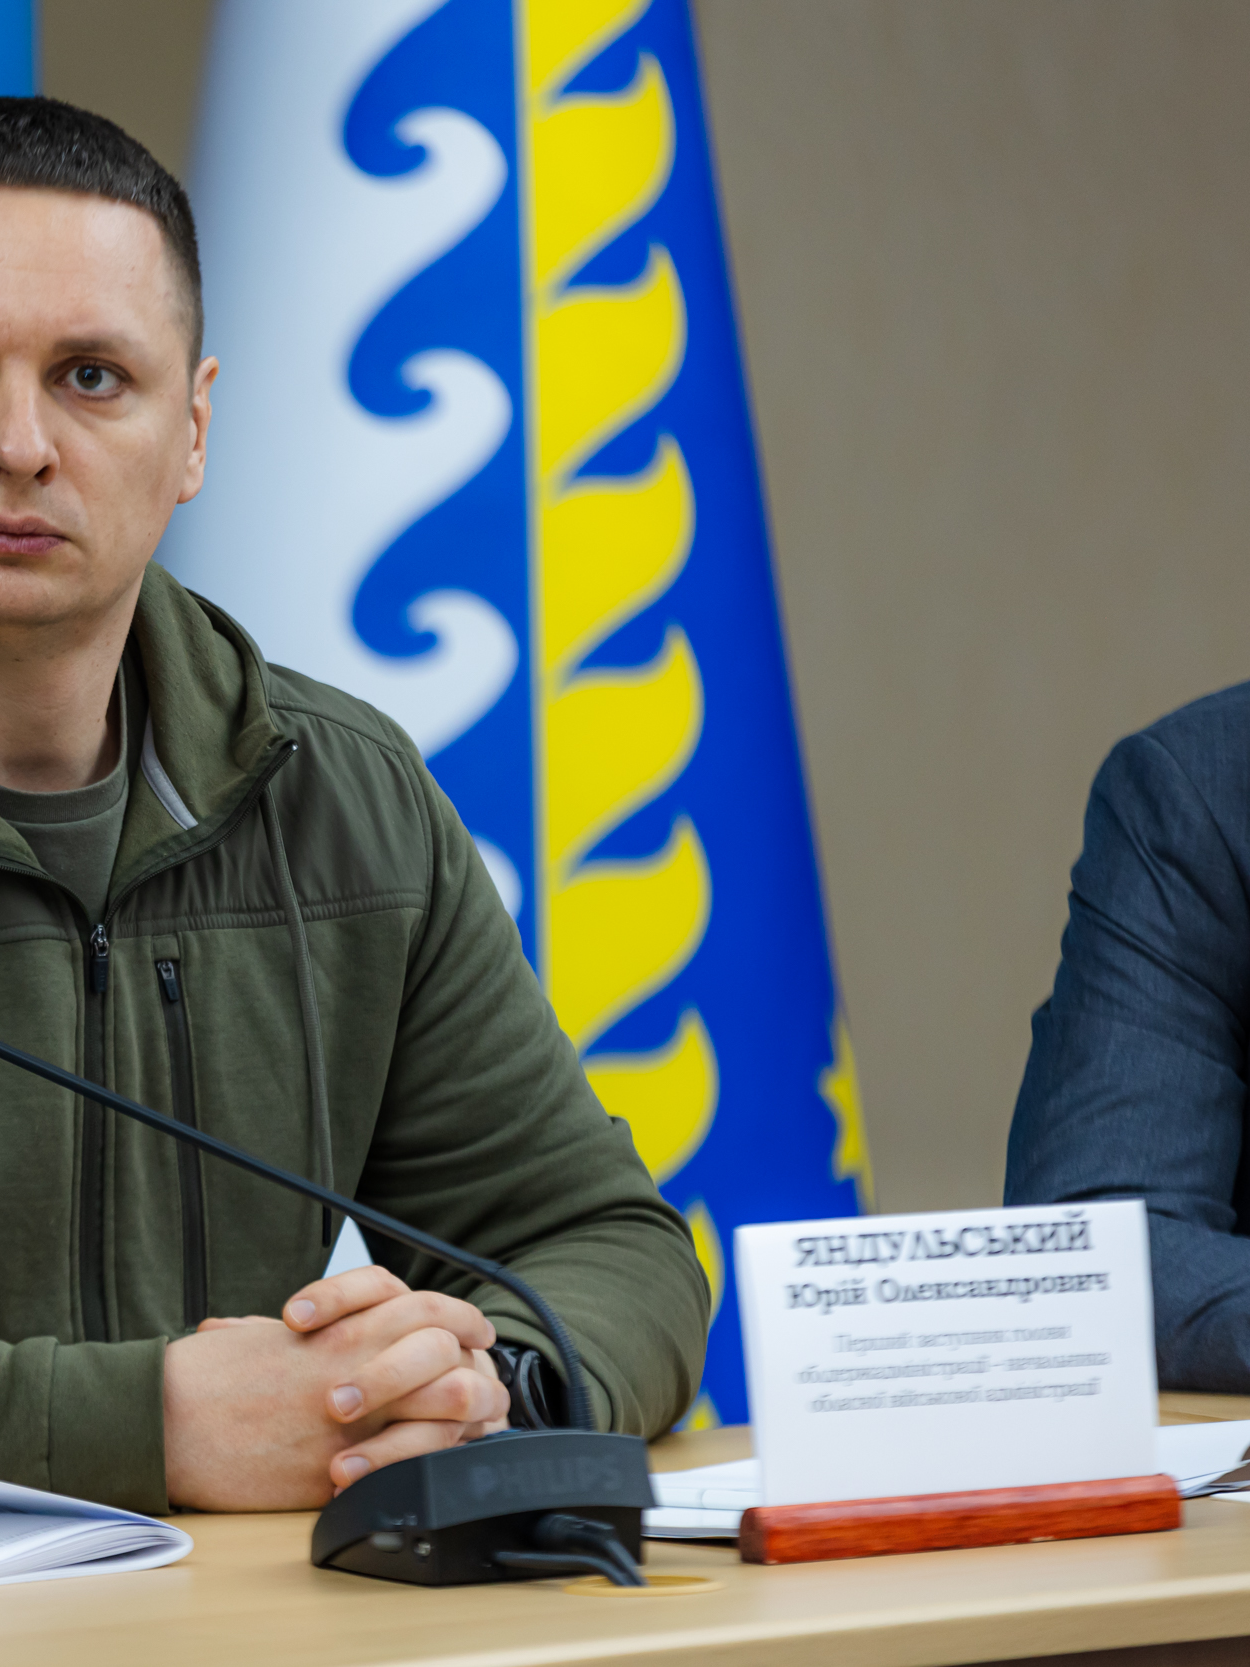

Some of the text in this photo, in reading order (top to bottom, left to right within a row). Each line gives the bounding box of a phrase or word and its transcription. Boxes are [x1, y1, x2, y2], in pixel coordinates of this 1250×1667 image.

[795, 1210, 1094, 1268] ЯНДУЛЬСЬКИЙ
[785, 1271, 1112, 1316] Юрій Олександрович
